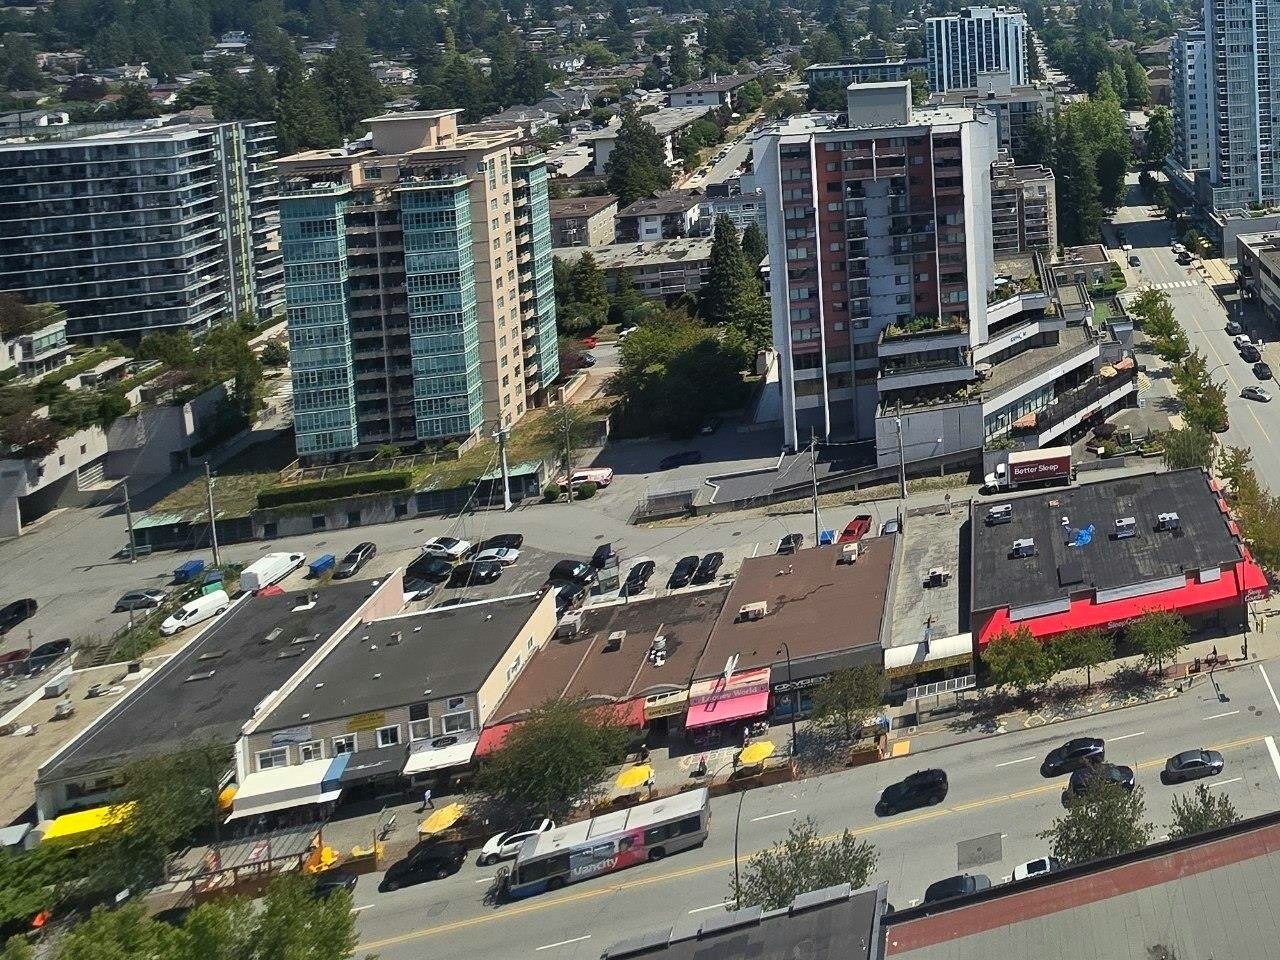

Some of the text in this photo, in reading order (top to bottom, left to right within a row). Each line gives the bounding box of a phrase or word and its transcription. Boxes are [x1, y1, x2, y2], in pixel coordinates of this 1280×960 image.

[1014, 466, 1037, 475] Better
[1038, 464, 1059, 472] Sleep
[734, 688, 758, 698] World
[573, 856, 618, 876] Vancity
